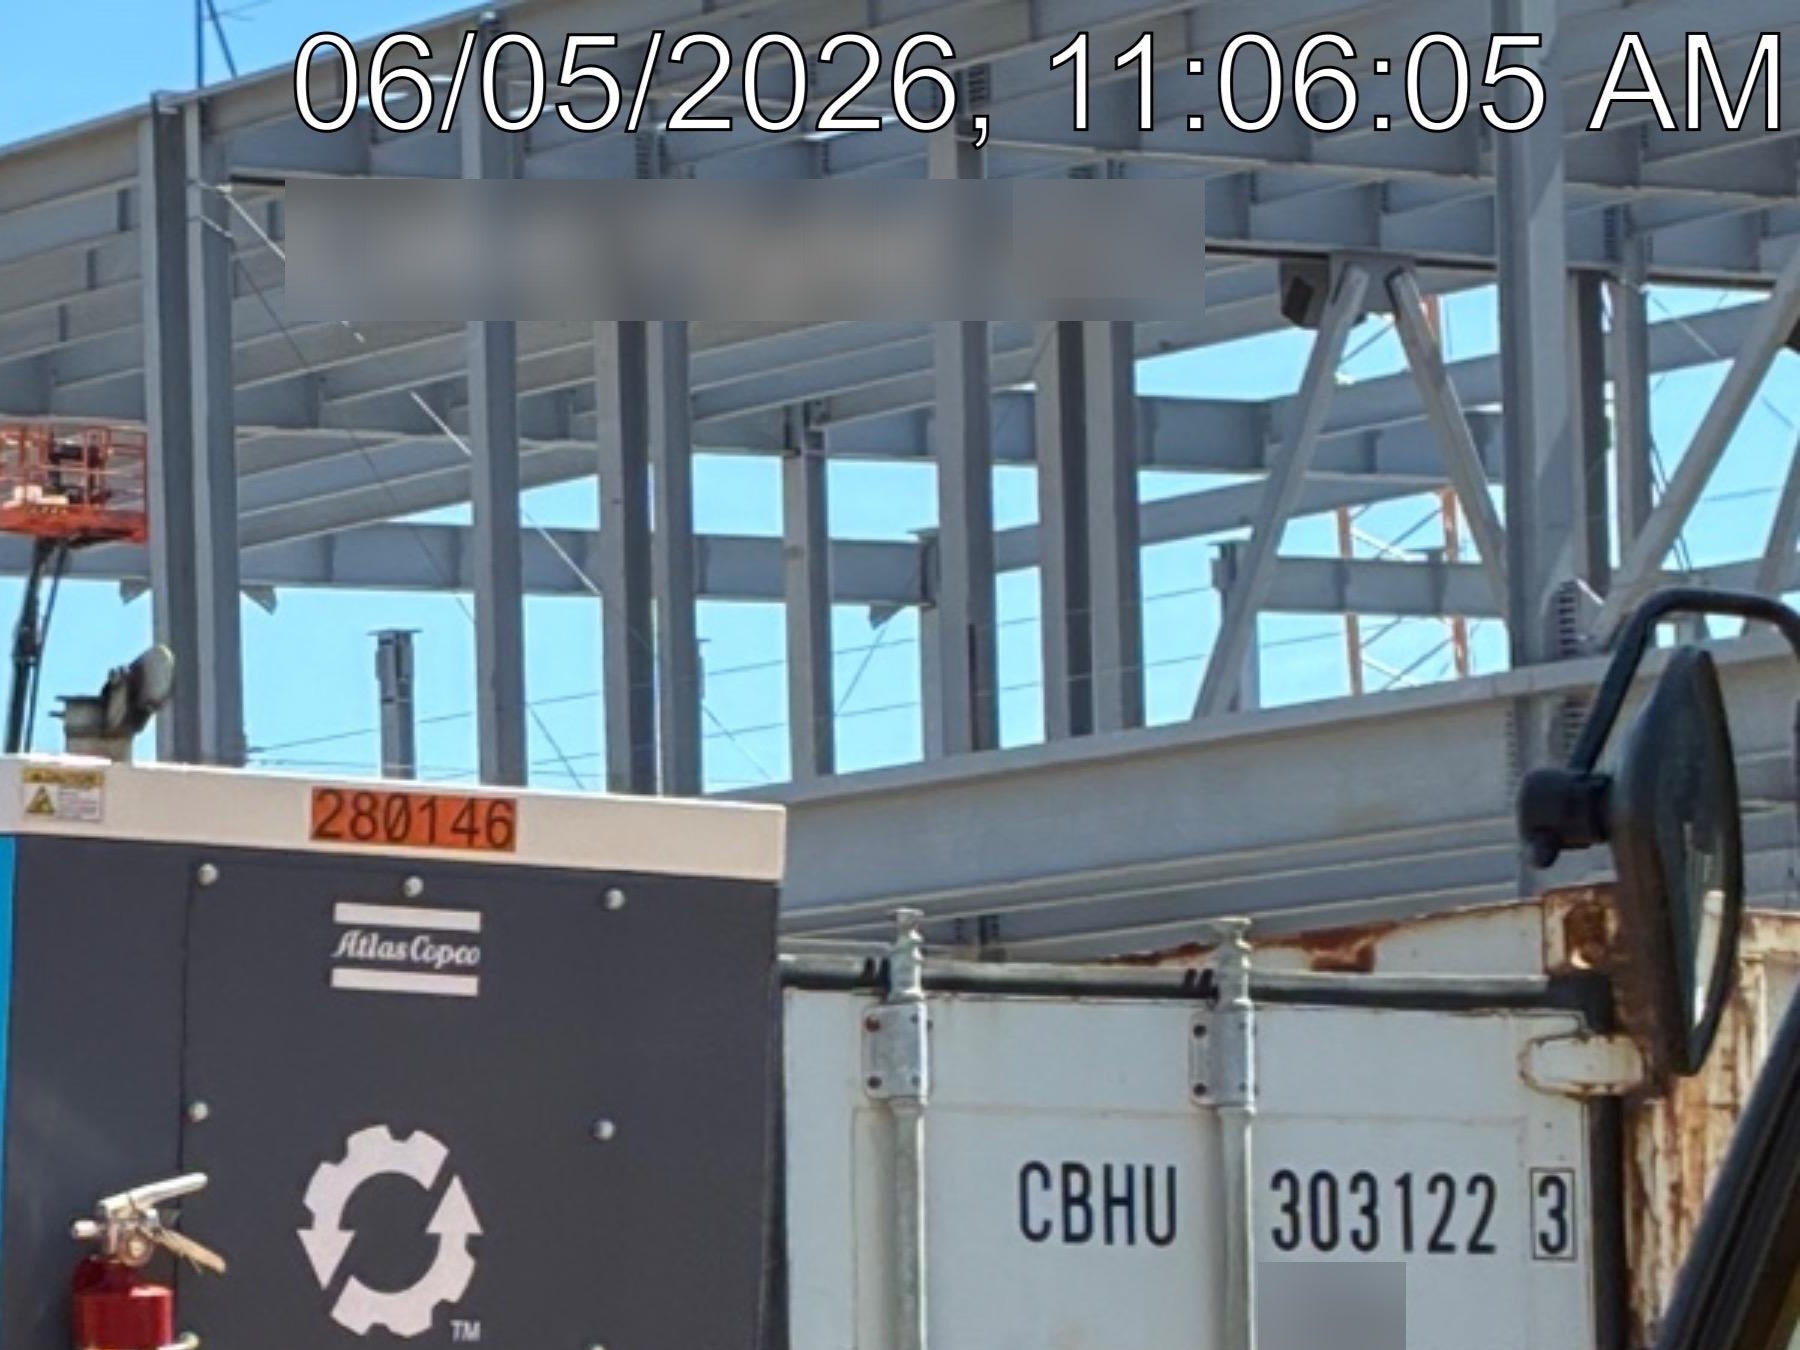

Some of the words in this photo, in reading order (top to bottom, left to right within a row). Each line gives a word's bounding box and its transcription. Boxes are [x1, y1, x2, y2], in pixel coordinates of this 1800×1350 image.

[313, 788, 513, 849] 280146
[331, 928, 408, 962] Atlas
[409, 934, 482, 970] Copco
[1018, 1159, 1178, 1248] CBHU
[1269, 1167, 1498, 1256] 303122
[1538, 1178, 1570, 1257] 3
